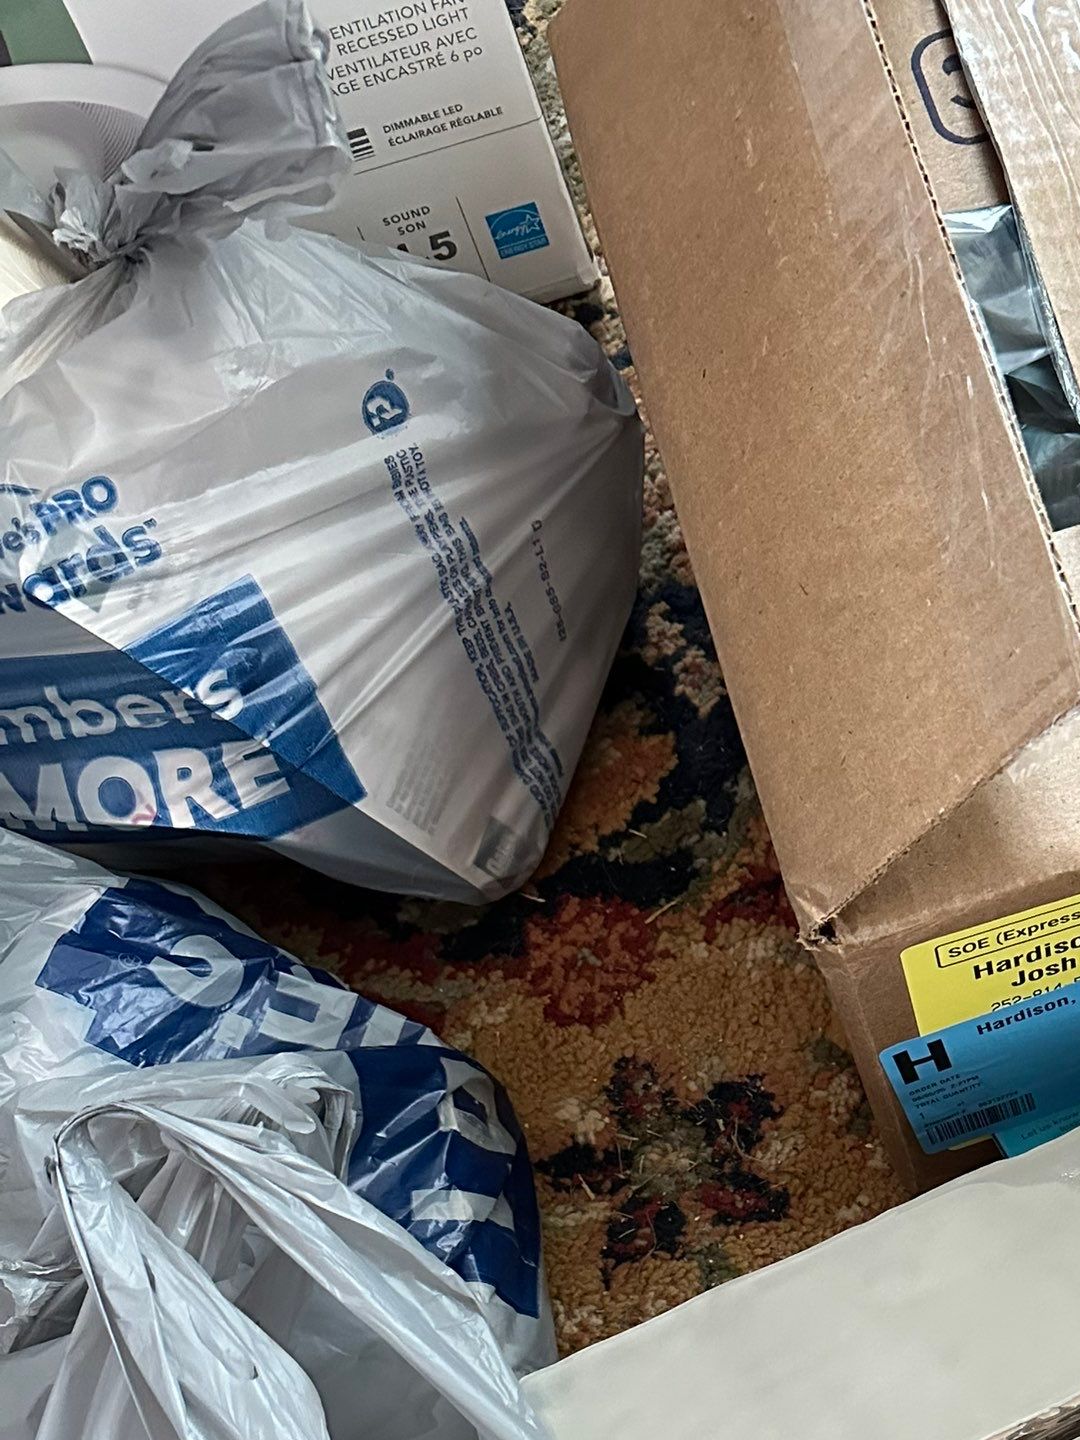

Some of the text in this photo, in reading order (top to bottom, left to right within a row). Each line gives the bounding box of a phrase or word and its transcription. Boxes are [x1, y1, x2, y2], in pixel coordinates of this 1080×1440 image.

[329, 2, 427, 40] ENTILATION
[336, 7, 469, 56] RECESSED LIGHT
[327, 27, 477, 81] VENTILATEUR AVEC
[363, 51, 447, 87] ENCASTRÉ
[450, 50, 459, 62] 6
[463, 47, 483, 62] po
[382, 104, 463, 134] DIMMABLE LED
[388, 106, 503, 147] ÉCLAIRAGE RÉGLABLE
[382, 206, 430, 226] SOUND
[397, 220, 426, 236] SON
[462, 637, 478, 663] KEEP
[0, 740, 290, 832] MORE
[949, 938, 990, 958] SOE
[1011, 956, 1077, 987] Josh
[976, 996, 1077, 1037] Hardison,
[892, 1038, 952, 1085] H
[939, 1073, 960, 1084] DATE
